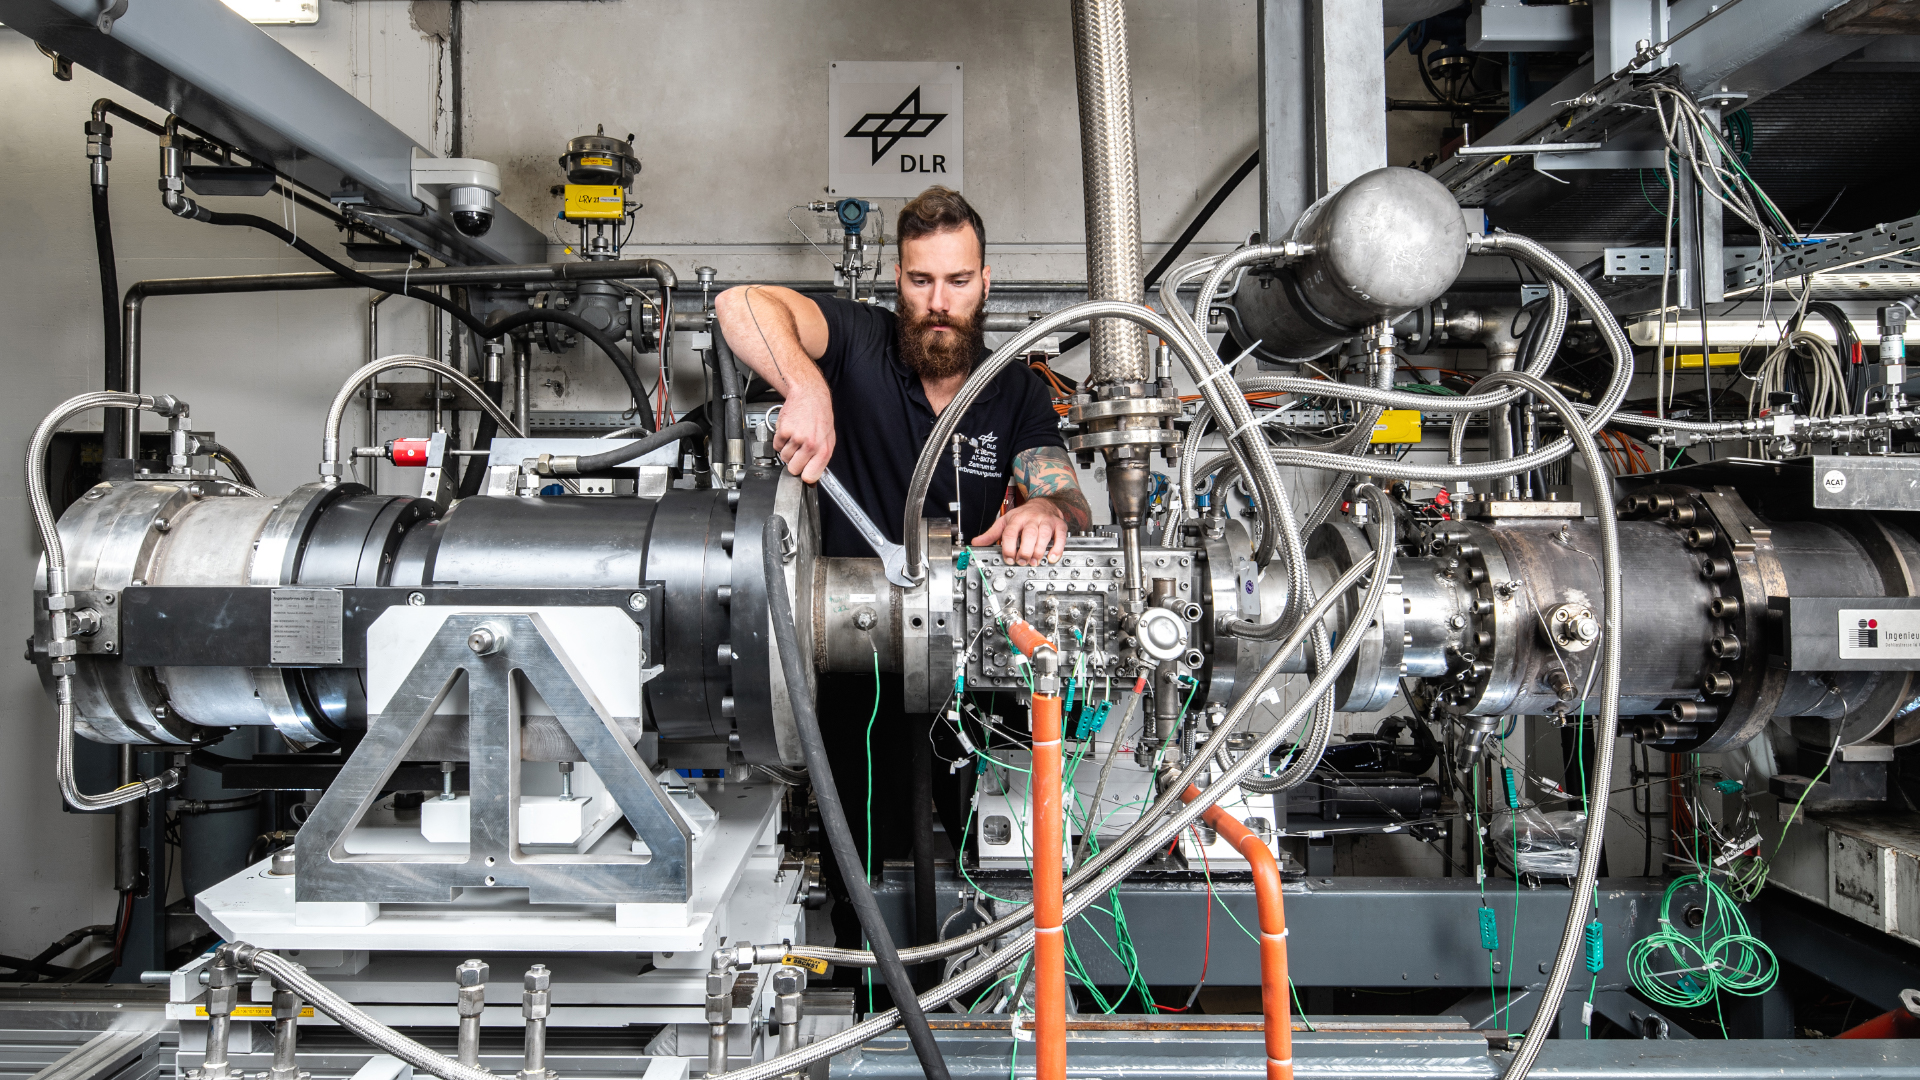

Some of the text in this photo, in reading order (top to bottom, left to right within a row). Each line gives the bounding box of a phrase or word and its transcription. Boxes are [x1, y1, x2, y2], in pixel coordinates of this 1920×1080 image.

[900, 154, 947, 173] DLR
[578, 194, 593, 204] LRV
[1885, 631, 1920, 642] Ingenieu
